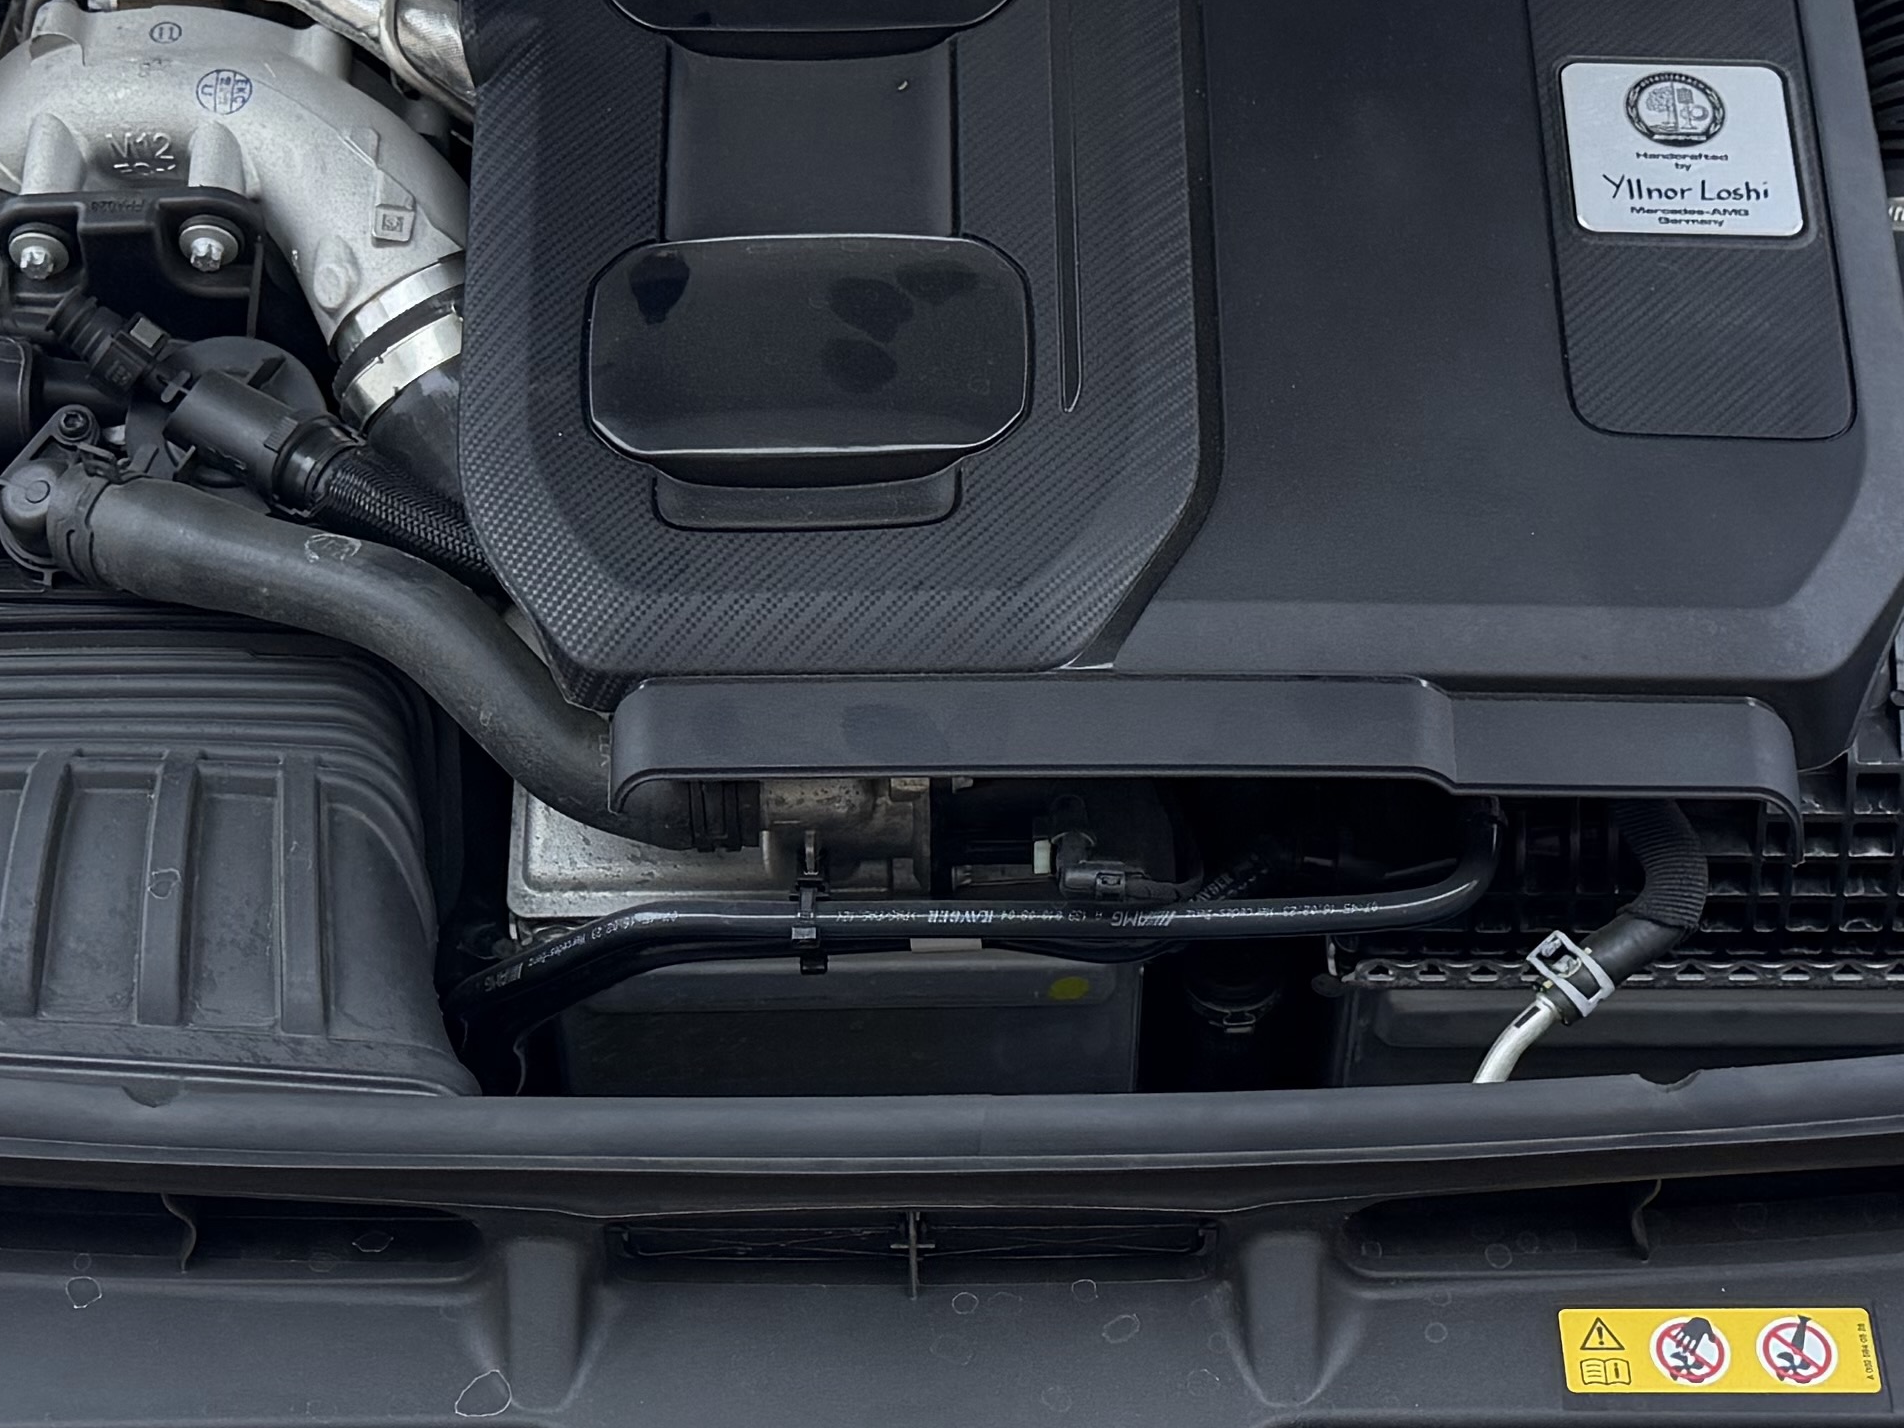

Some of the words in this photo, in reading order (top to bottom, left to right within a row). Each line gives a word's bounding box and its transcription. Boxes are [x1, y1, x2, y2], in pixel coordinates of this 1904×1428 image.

[1636, 151, 1729, 161] Handcrafted
[1674, 162, 1692, 172] by
[1700, 180, 1769, 201] Loshi
[1630, 206, 1750, 217] Mercedes-AMG
[1657, 216, 1725, 227] Germany
